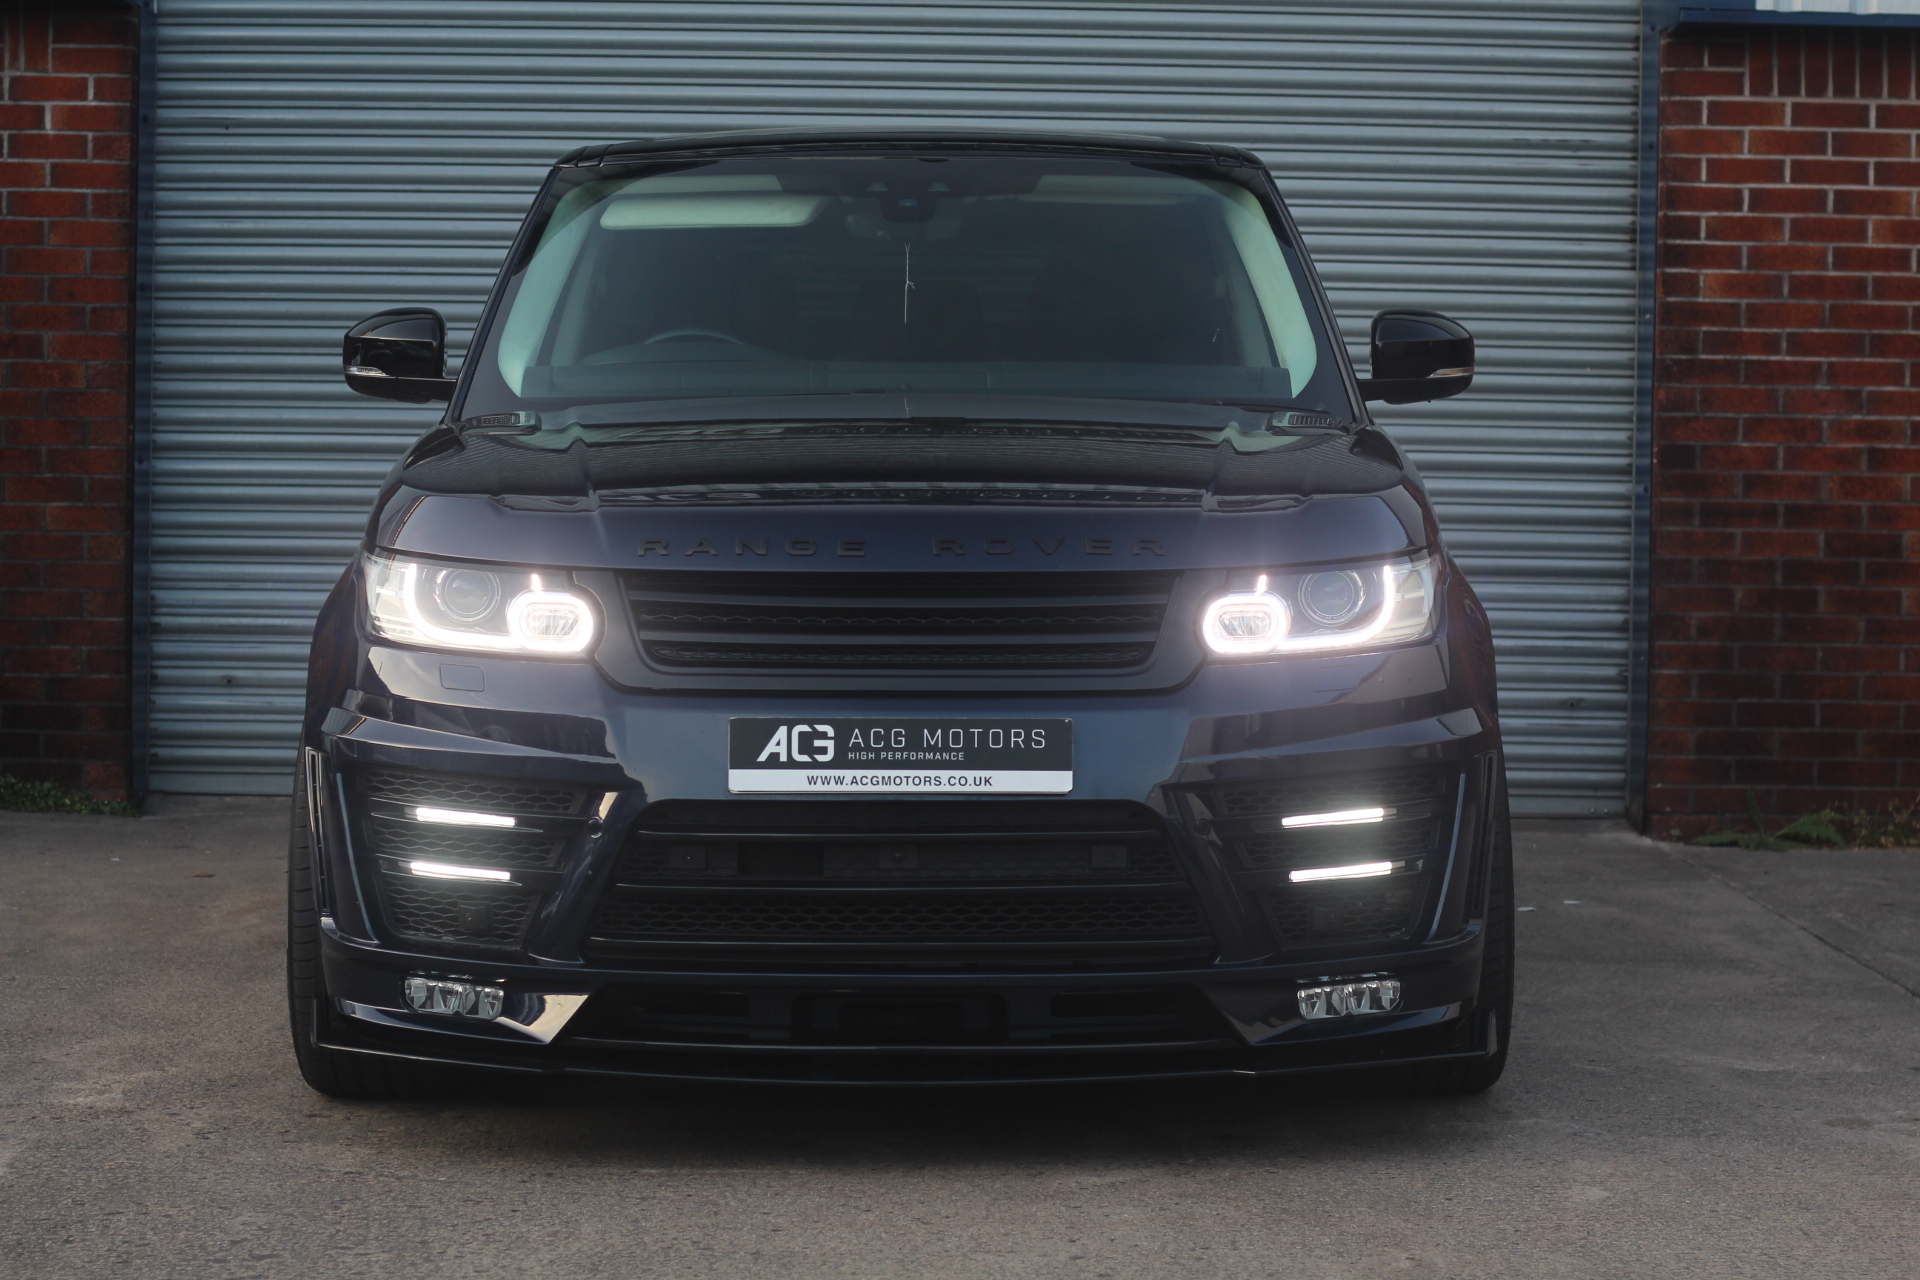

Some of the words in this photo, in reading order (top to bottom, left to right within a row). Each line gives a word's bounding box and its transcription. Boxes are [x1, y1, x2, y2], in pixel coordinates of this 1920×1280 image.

[637, 536, 866, 557] RANGE
[932, 536, 1166, 557] ROVER
[756, 724, 835, 762] ACG
[848, 728, 906, 748] ACG
[923, 729, 1046, 749] MOTORS
[848, 752, 876, 760] HIGH
[880, 751, 965, 761] PERFORMANCE
[806, 775, 994, 787] WWW.ACGMOTORS.CO.UK
